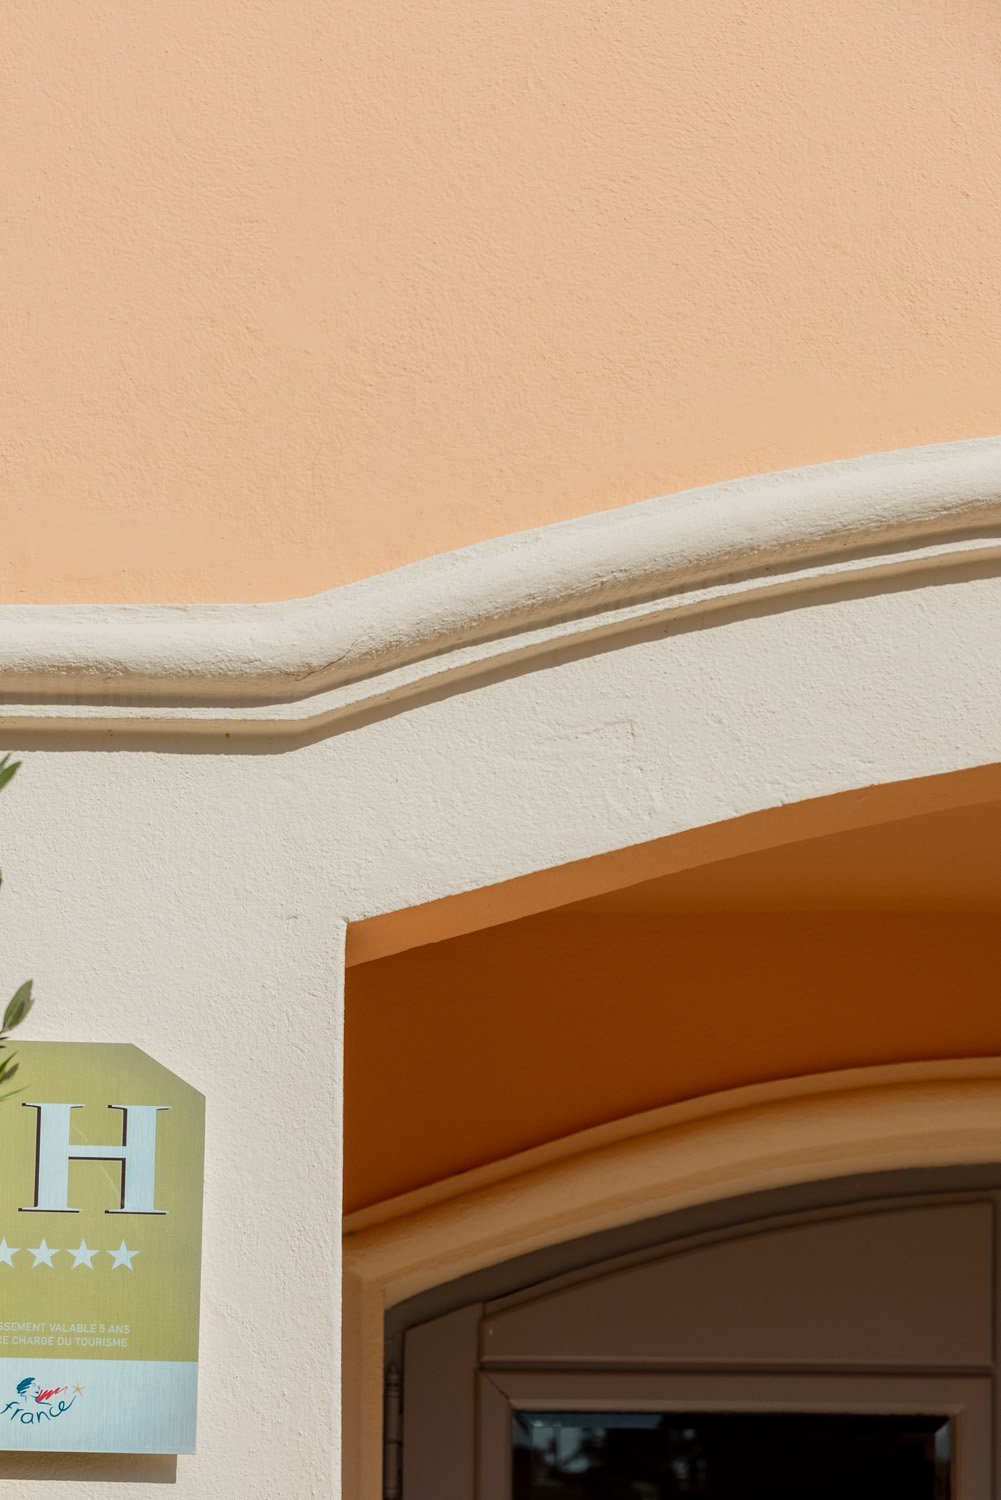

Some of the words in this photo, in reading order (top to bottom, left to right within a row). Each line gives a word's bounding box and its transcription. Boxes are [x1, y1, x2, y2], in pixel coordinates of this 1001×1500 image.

[18, 1102, 172, 1215] H
[49, 1323, 97, 1333] VALABLE
[100, 1324, 105, 1333] 5
[106, 1324, 130, 1334] ANS
[57, 1337, 72, 1346] DU
[75, 1337, 128, 1348] TOURISME
